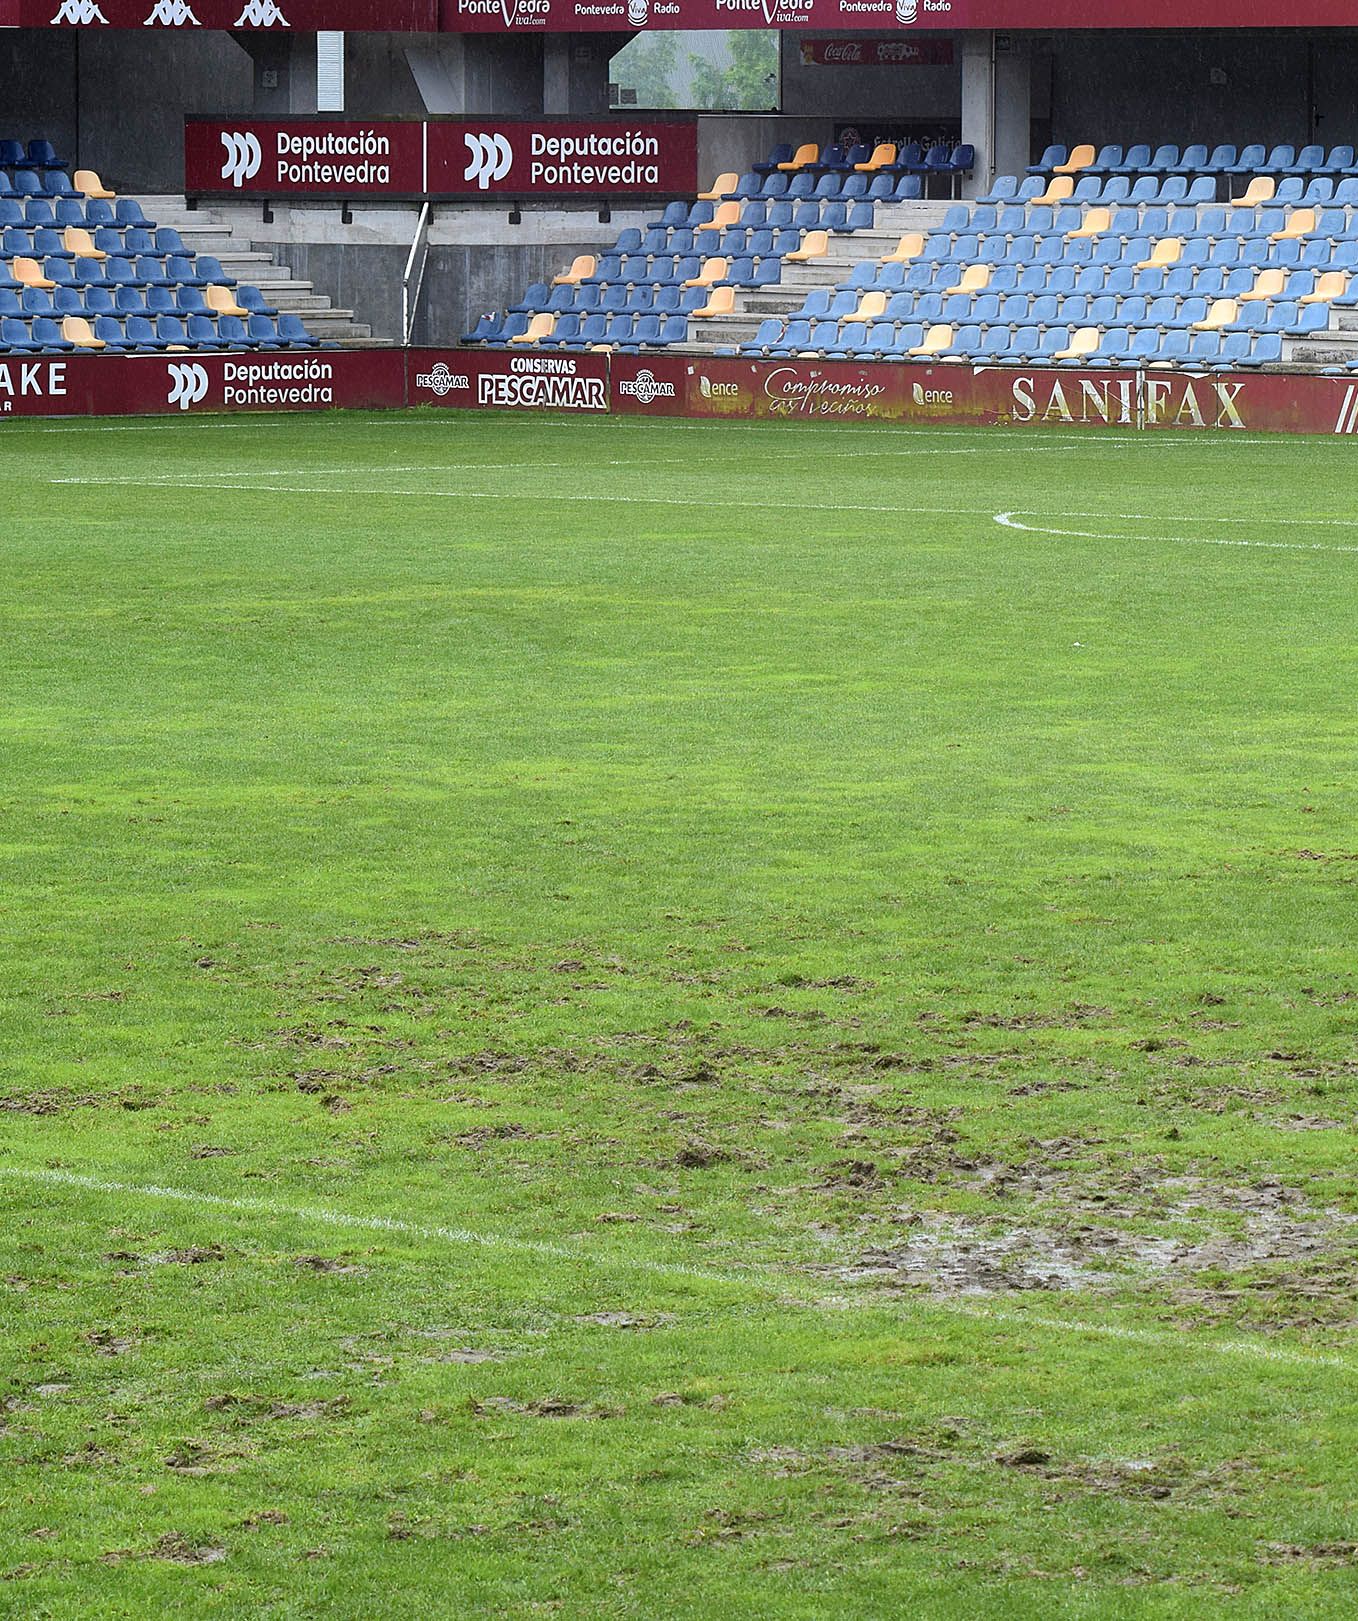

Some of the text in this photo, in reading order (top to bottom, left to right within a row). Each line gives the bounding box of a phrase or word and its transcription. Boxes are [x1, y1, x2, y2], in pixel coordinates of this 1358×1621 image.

[575, 4, 624, 15] Pontevedra
[654, 3, 680, 14] Radio
[840, 0, 892, 12] Pontevedra
[923, 0, 951, 11] Radio
[276, 130, 390, 160] Deputación
[530, 131, 659, 162] Deputación
[276, 160, 390, 184] Pontevedra
[530, 161, 659, 184] Pontevedra
[223, 359, 332, 386] Deputación
[510, 357, 577, 375] CONSERVAS
[416, 374, 470, 389] PESCAMAR
[477, 373, 607, 409] PESCAMAR
[619, 380, 676, 397] PESCAMAR
[711, 382, 739, 396] ence
[223, 383, 332, 405] Pontevedra
[924, 389, 953, 404] ence
[1011, 376, 1247, 429] SANIFAX
